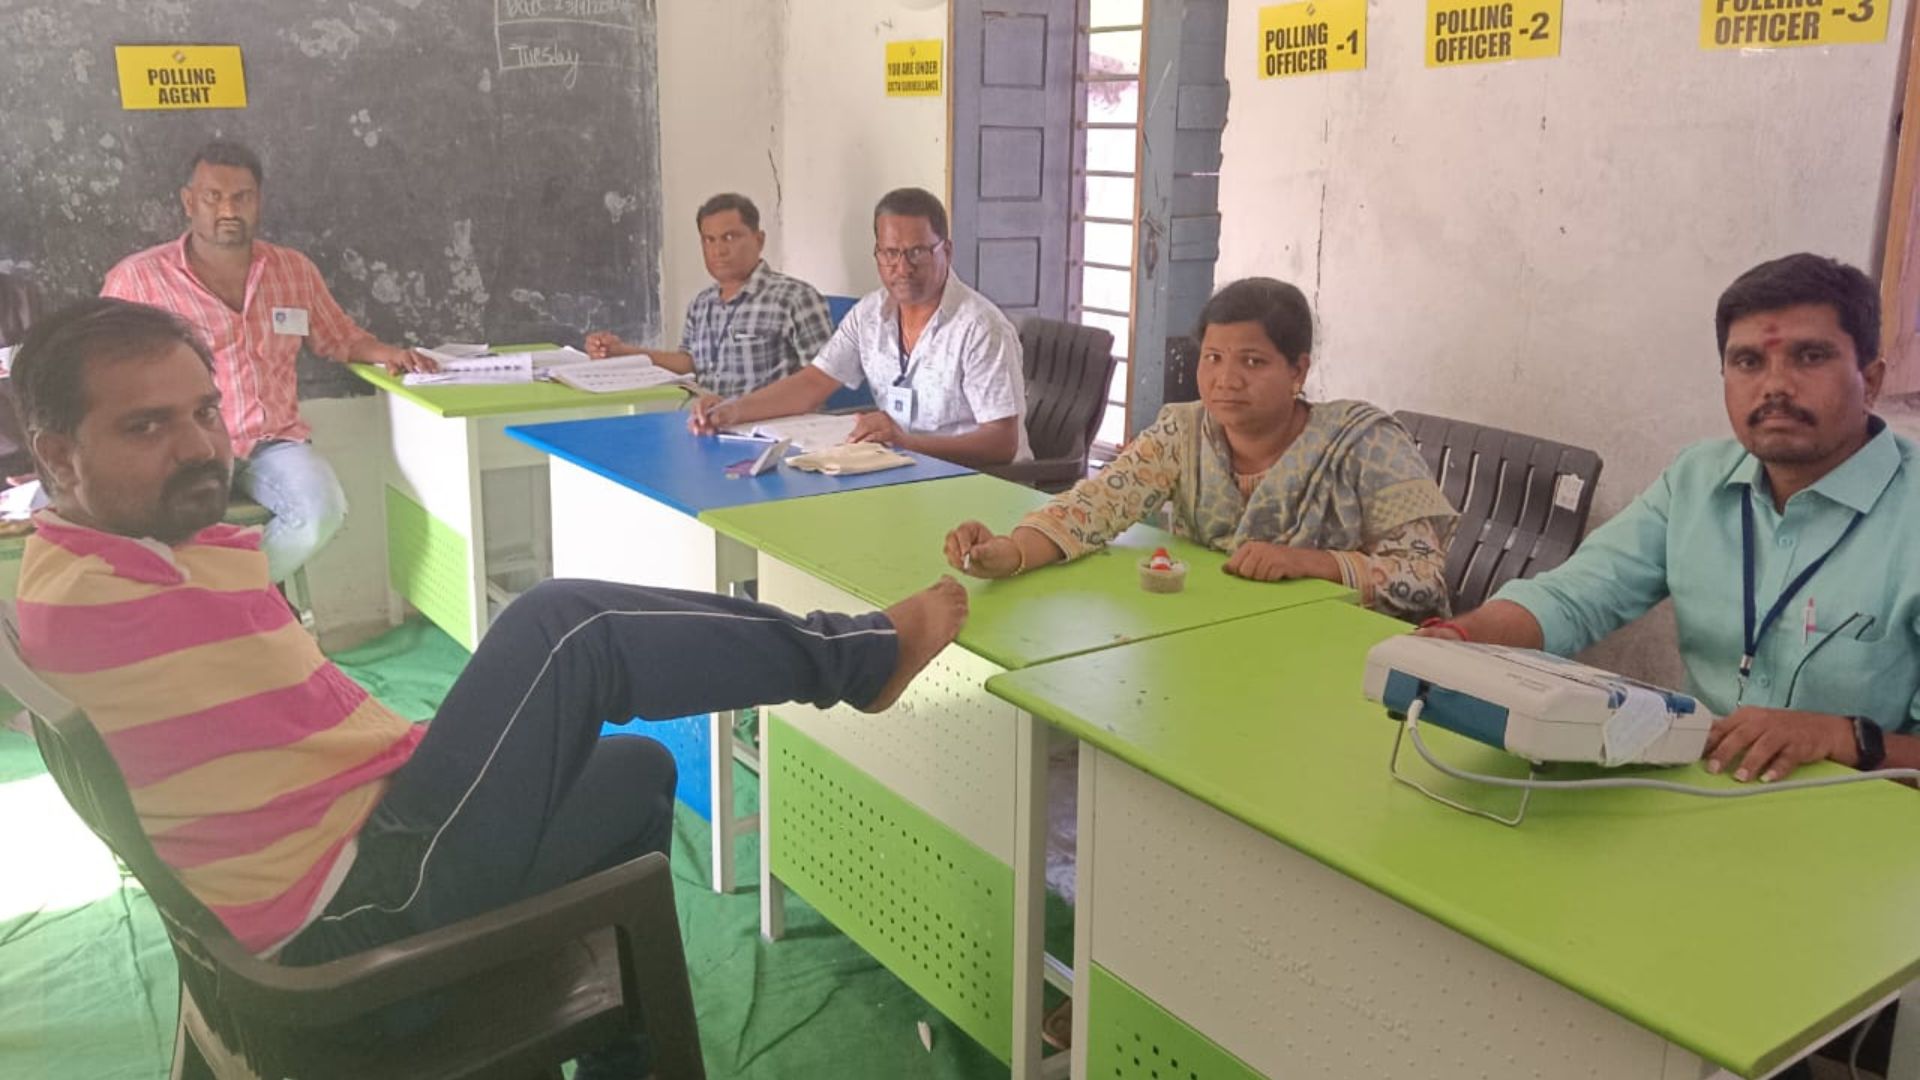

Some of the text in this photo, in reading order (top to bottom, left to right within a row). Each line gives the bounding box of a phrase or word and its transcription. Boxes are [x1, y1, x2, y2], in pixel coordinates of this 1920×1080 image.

[1435, 2, 1513, 36] POLLING
[1832, 0, 1874, 22] -3
[1265, 21, 1329, 52] POLLING
[1518, 12, 1550, 41] -2
[1714, 11, 1821, 45] OFFICER
[1336, 29, 1358, 55] -1
[1435, 31, 1512, 63] OFFICER
[509, 43, 580, 90] Tuesday
[887, 60, 938, 76] YOU ARE UNDER
[1265, 48, 1328, 76] OFFICER
[147, 67, 217, 86] POLLING
[158, 86, 212, 105] AGENT
